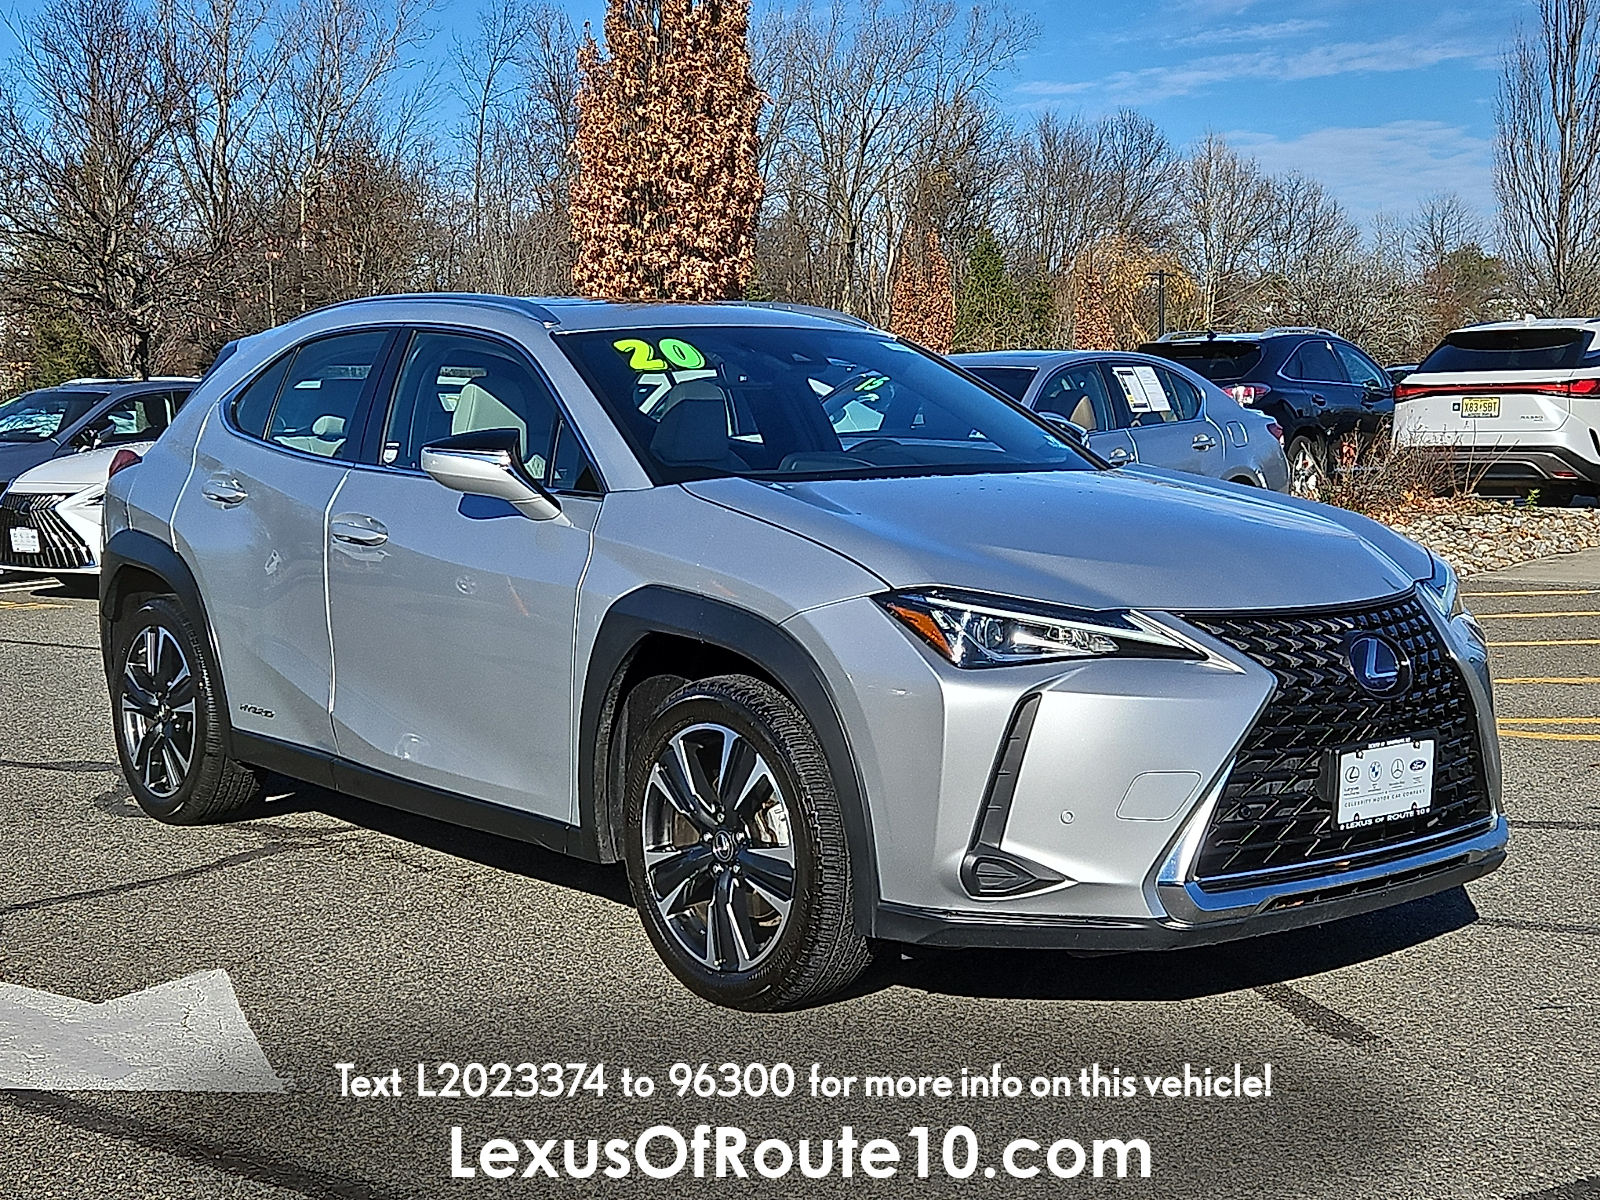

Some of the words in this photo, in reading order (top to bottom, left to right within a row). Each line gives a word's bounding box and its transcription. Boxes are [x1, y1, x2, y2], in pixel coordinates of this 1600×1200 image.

[613, 338, 706, 371] 20
[1372, 795, 1390, 803] MOTOR
[1345, 819, 1373, 830] LEXUS
[1386, 810, 1415, 822] ROUTE
[1416, 808, 1426, 816] 10
